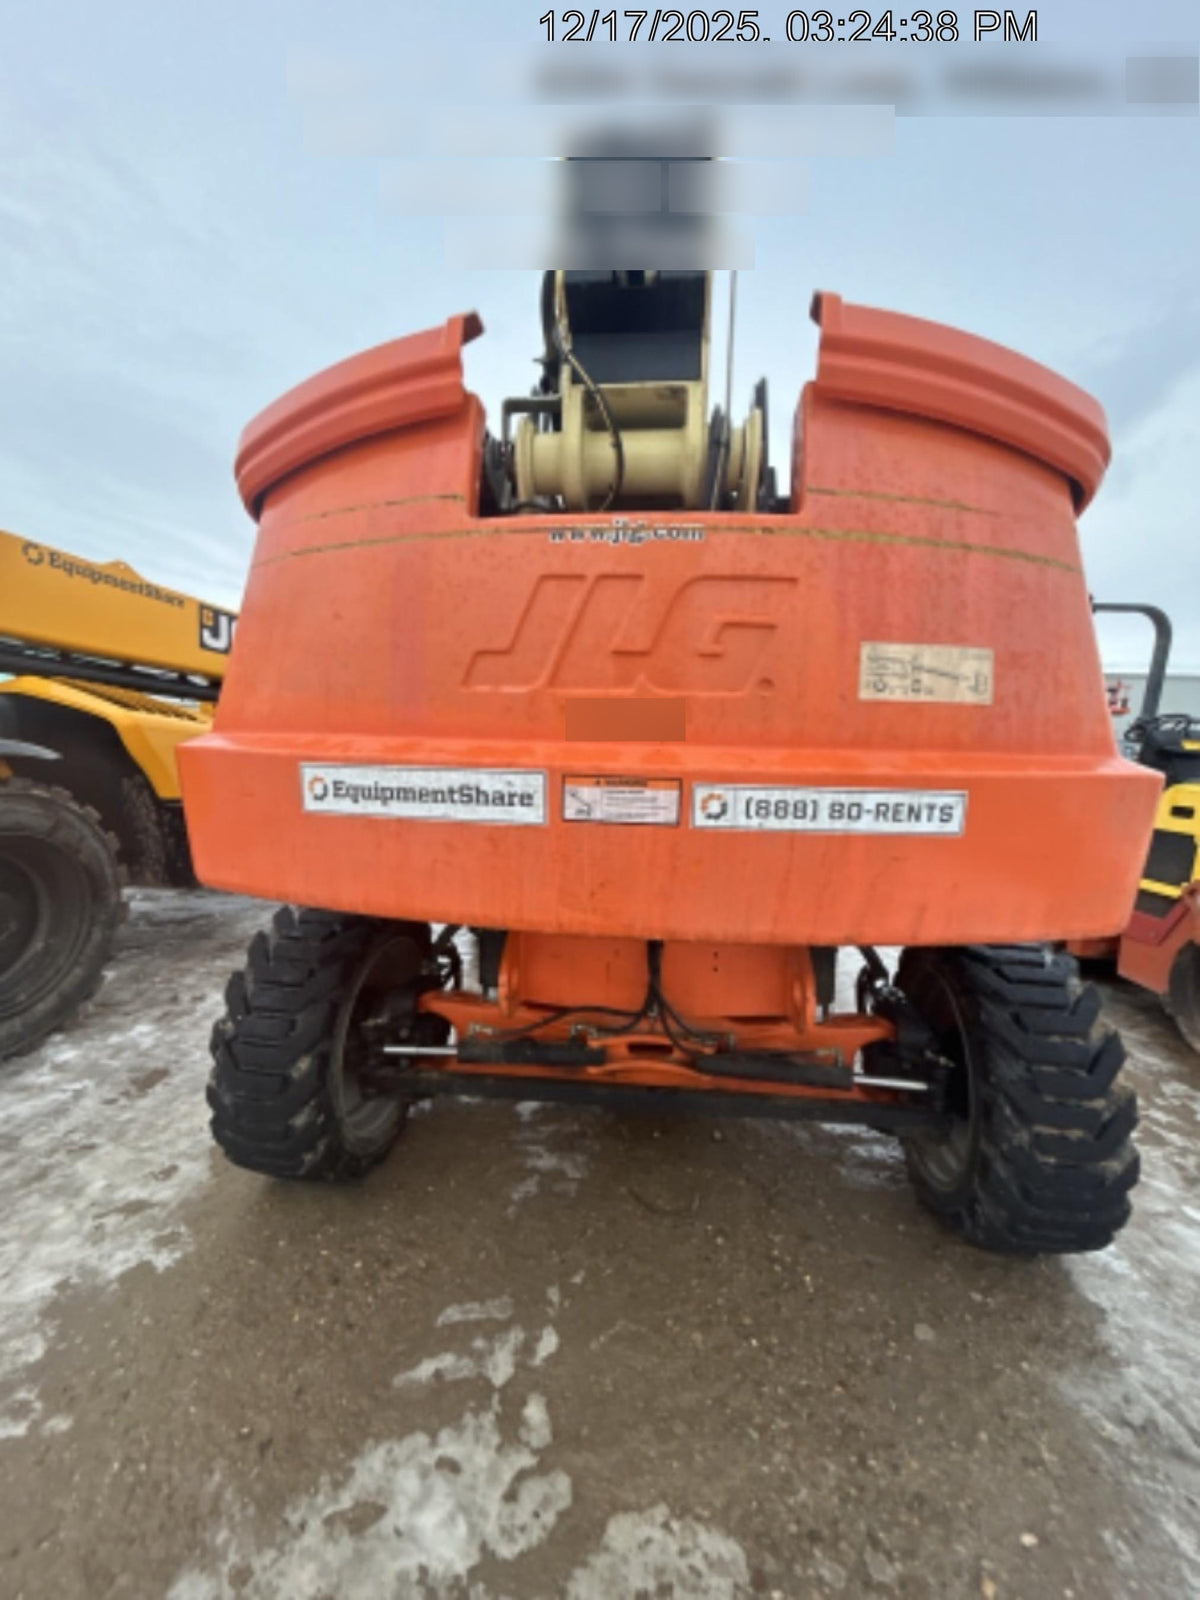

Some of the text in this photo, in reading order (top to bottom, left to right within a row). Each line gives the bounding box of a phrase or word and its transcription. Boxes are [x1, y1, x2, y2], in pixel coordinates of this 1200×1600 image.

[460, 574, 798, 696] JLG
[332, 780, 535, 807] EquipmentShare
[745, 797, 818, 821] (888)
